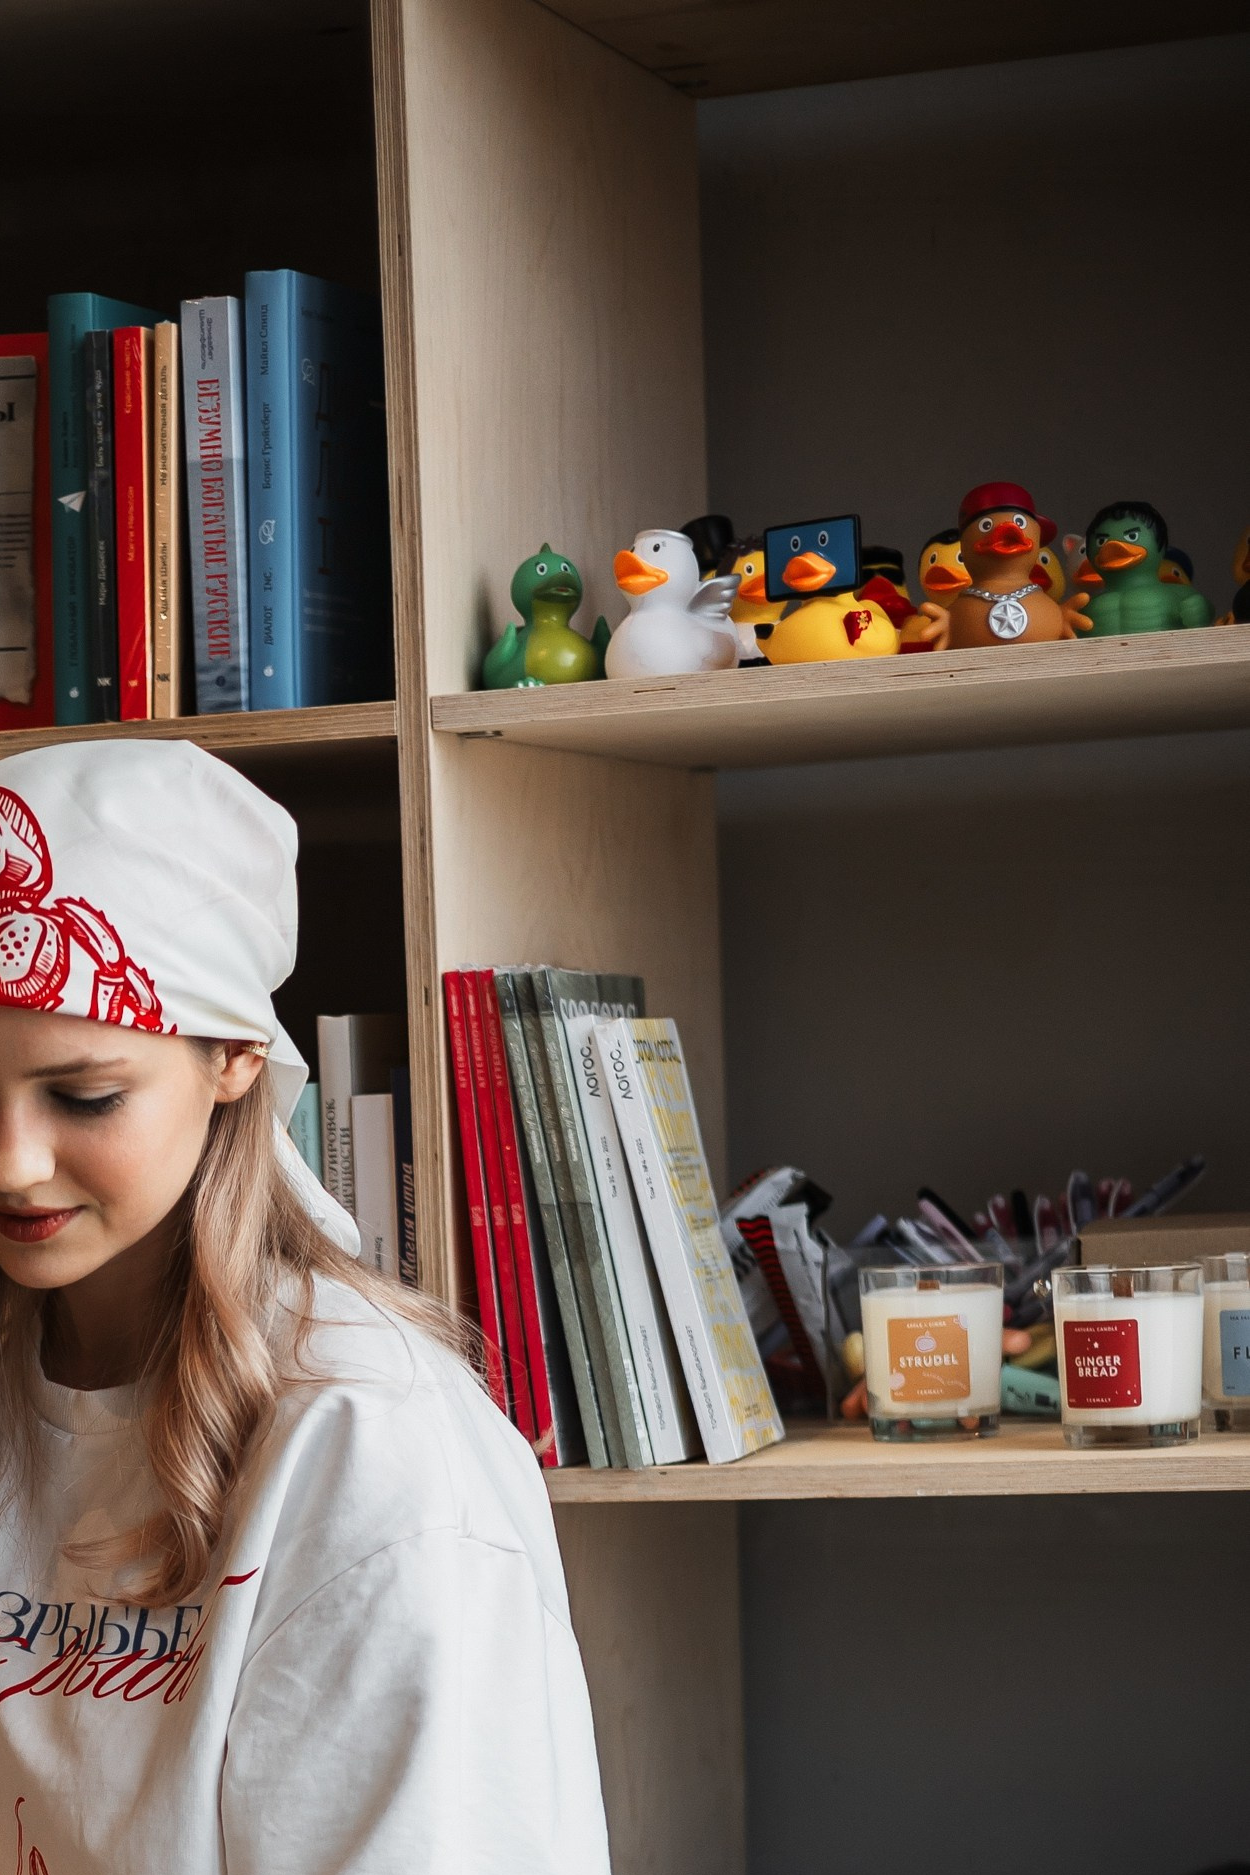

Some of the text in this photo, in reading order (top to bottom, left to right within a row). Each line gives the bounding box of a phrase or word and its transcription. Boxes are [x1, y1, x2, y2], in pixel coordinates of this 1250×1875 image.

[159, 365, 168, 401] деталь
[260, 304, 273, 489] Борис Гройсберг Майкл Слинд
[197, 378, 231, 661] БЕЗУМНО БОГАТЫЕ РУССКИЕ
[98, 582, 107, 605] Мари
[263, 567, 274, 646] ДИАЛОГ INC.
[400, 1162, 419, 1287] Магия утра
[899, 1352, 959, 1369] STRUDEL
[1075, 1355, 1122, 1368] GINGER
[1078, 1366, 1119, 1378] BREAD
